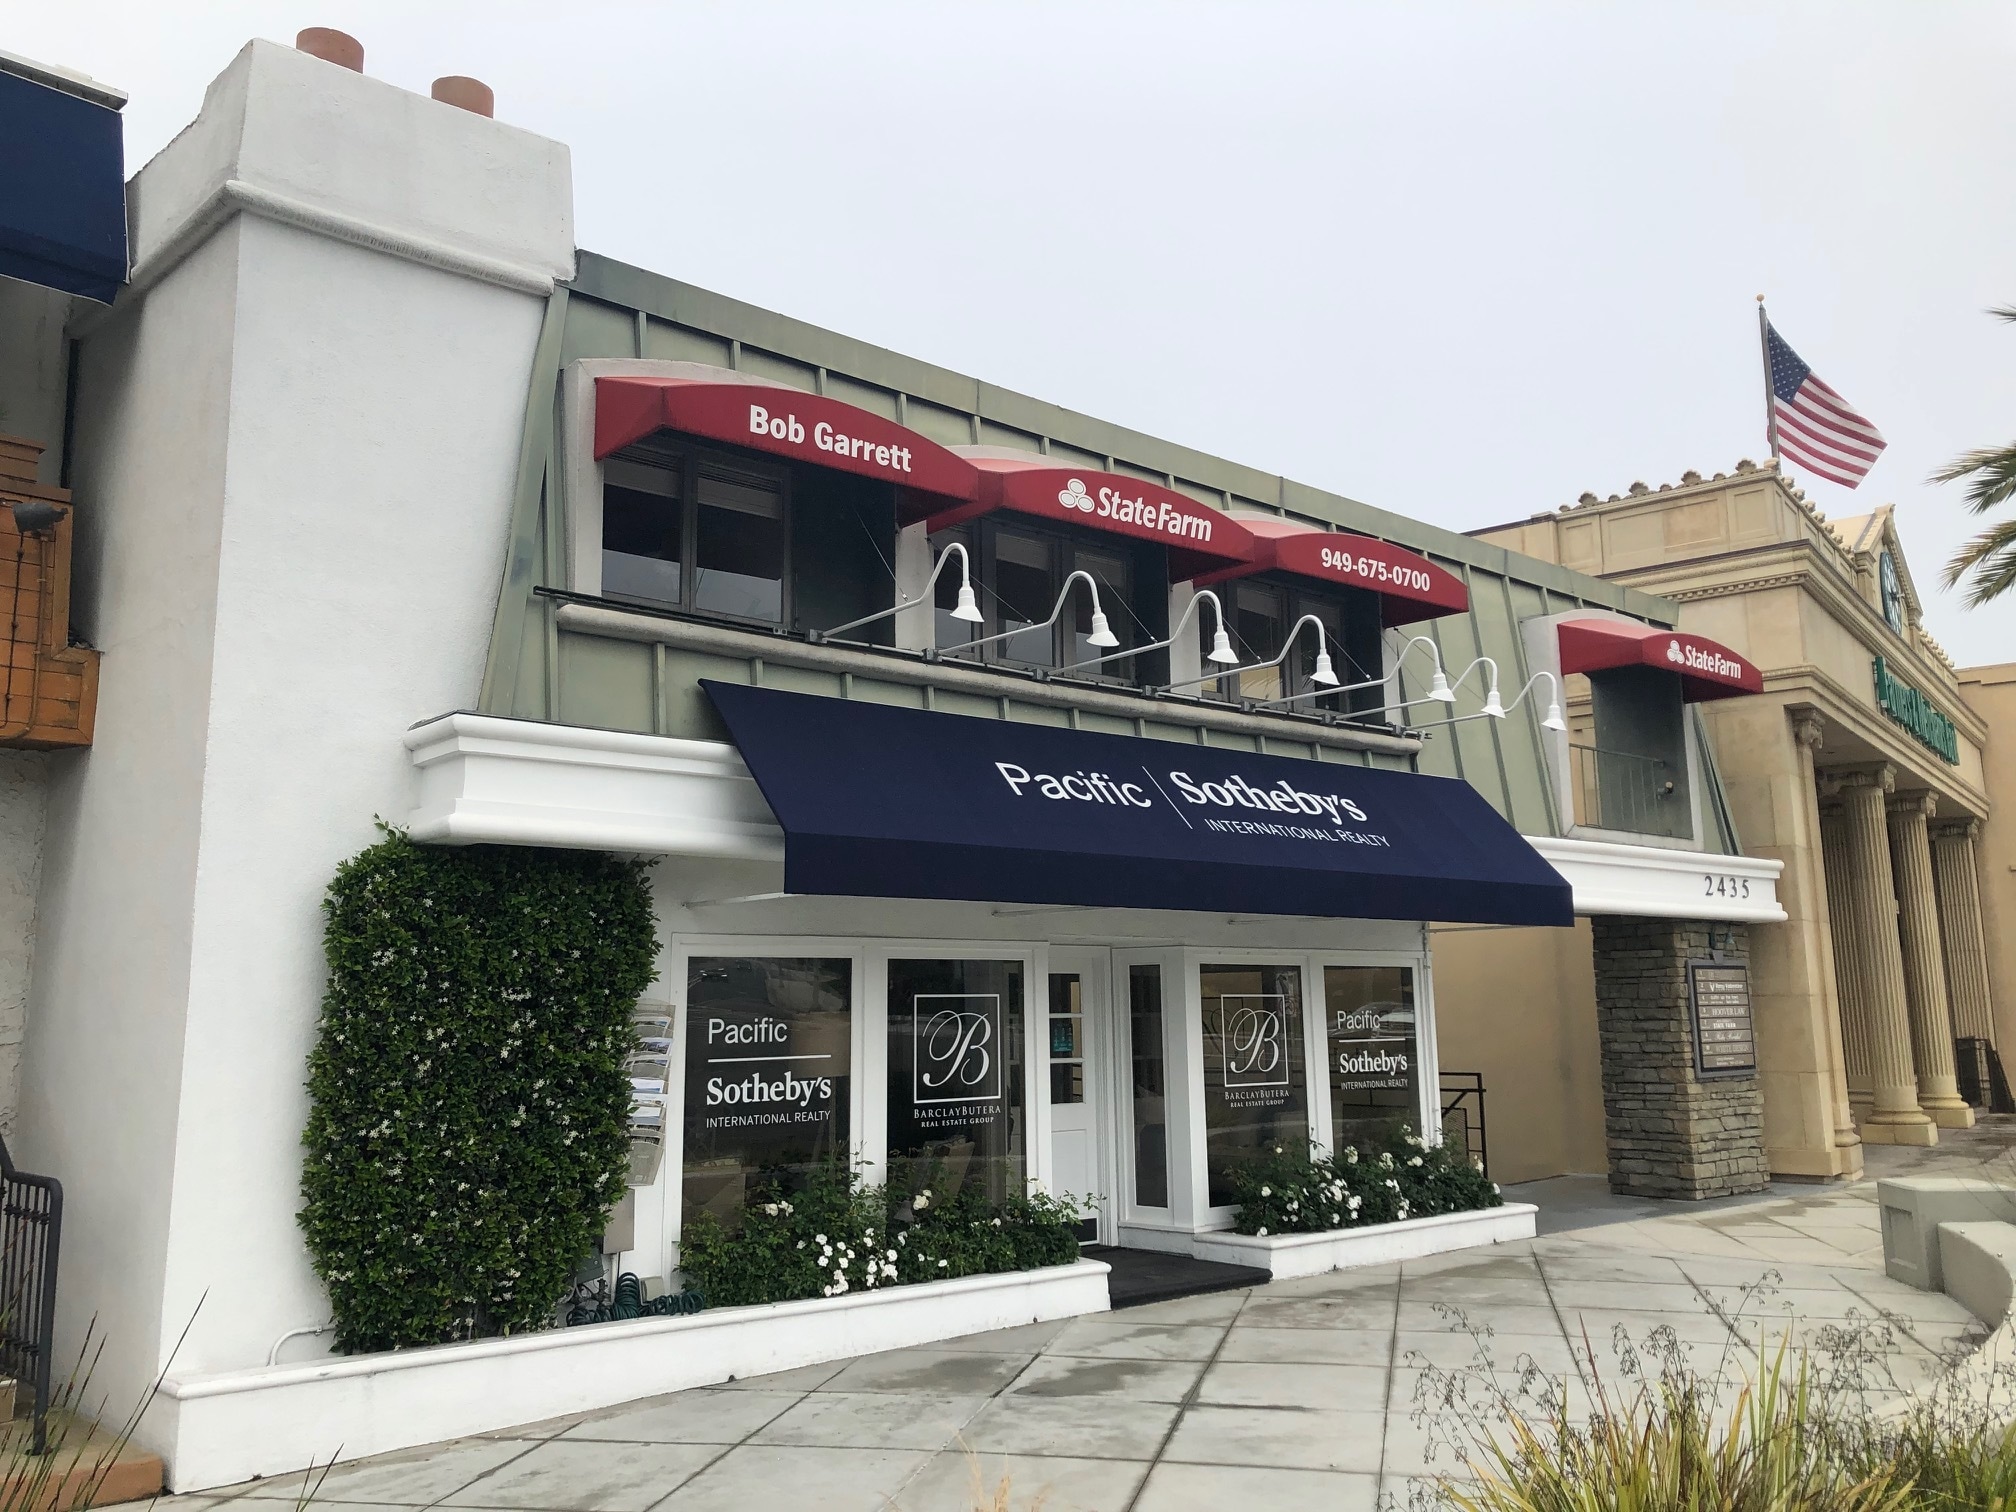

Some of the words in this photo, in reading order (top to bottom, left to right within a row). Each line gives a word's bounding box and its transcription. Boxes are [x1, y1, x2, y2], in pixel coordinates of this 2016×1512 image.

[749, 404, 805, 444] Bob
[814, 421, 912, 473] Garrett
[1321, 547, 1430, 592] 949-675-0700
[995, 761, 1152, 808] Pacific
[1168, 771, 1368, 825] Sotheby's
[1204, 818, 1340, 842] INTERNATIONAL
[1335, 829, 1391, 847] REALTY
[1704, 875, 1750, 899] 2435
[708, 1017, 788, 1045] Pacific
[1337, 1010, 1381, 1030] Pacific
[1339, 1049, 1408, 1076] Sotheby's
[706, 1070, 832, 1107] Sotheby's
[1340, 1080, 1387, 1090] INTERNATIONAL
[1387, 1078, 1408, 1087] REALTY
[706, 1113, 792, 1129] INTERNATIONAL
[794, 1110, 831, 1123] REALTY
[941, 1118, 967, 1127] ESTATE
[969, 1116, 995, 1125] GROUP
